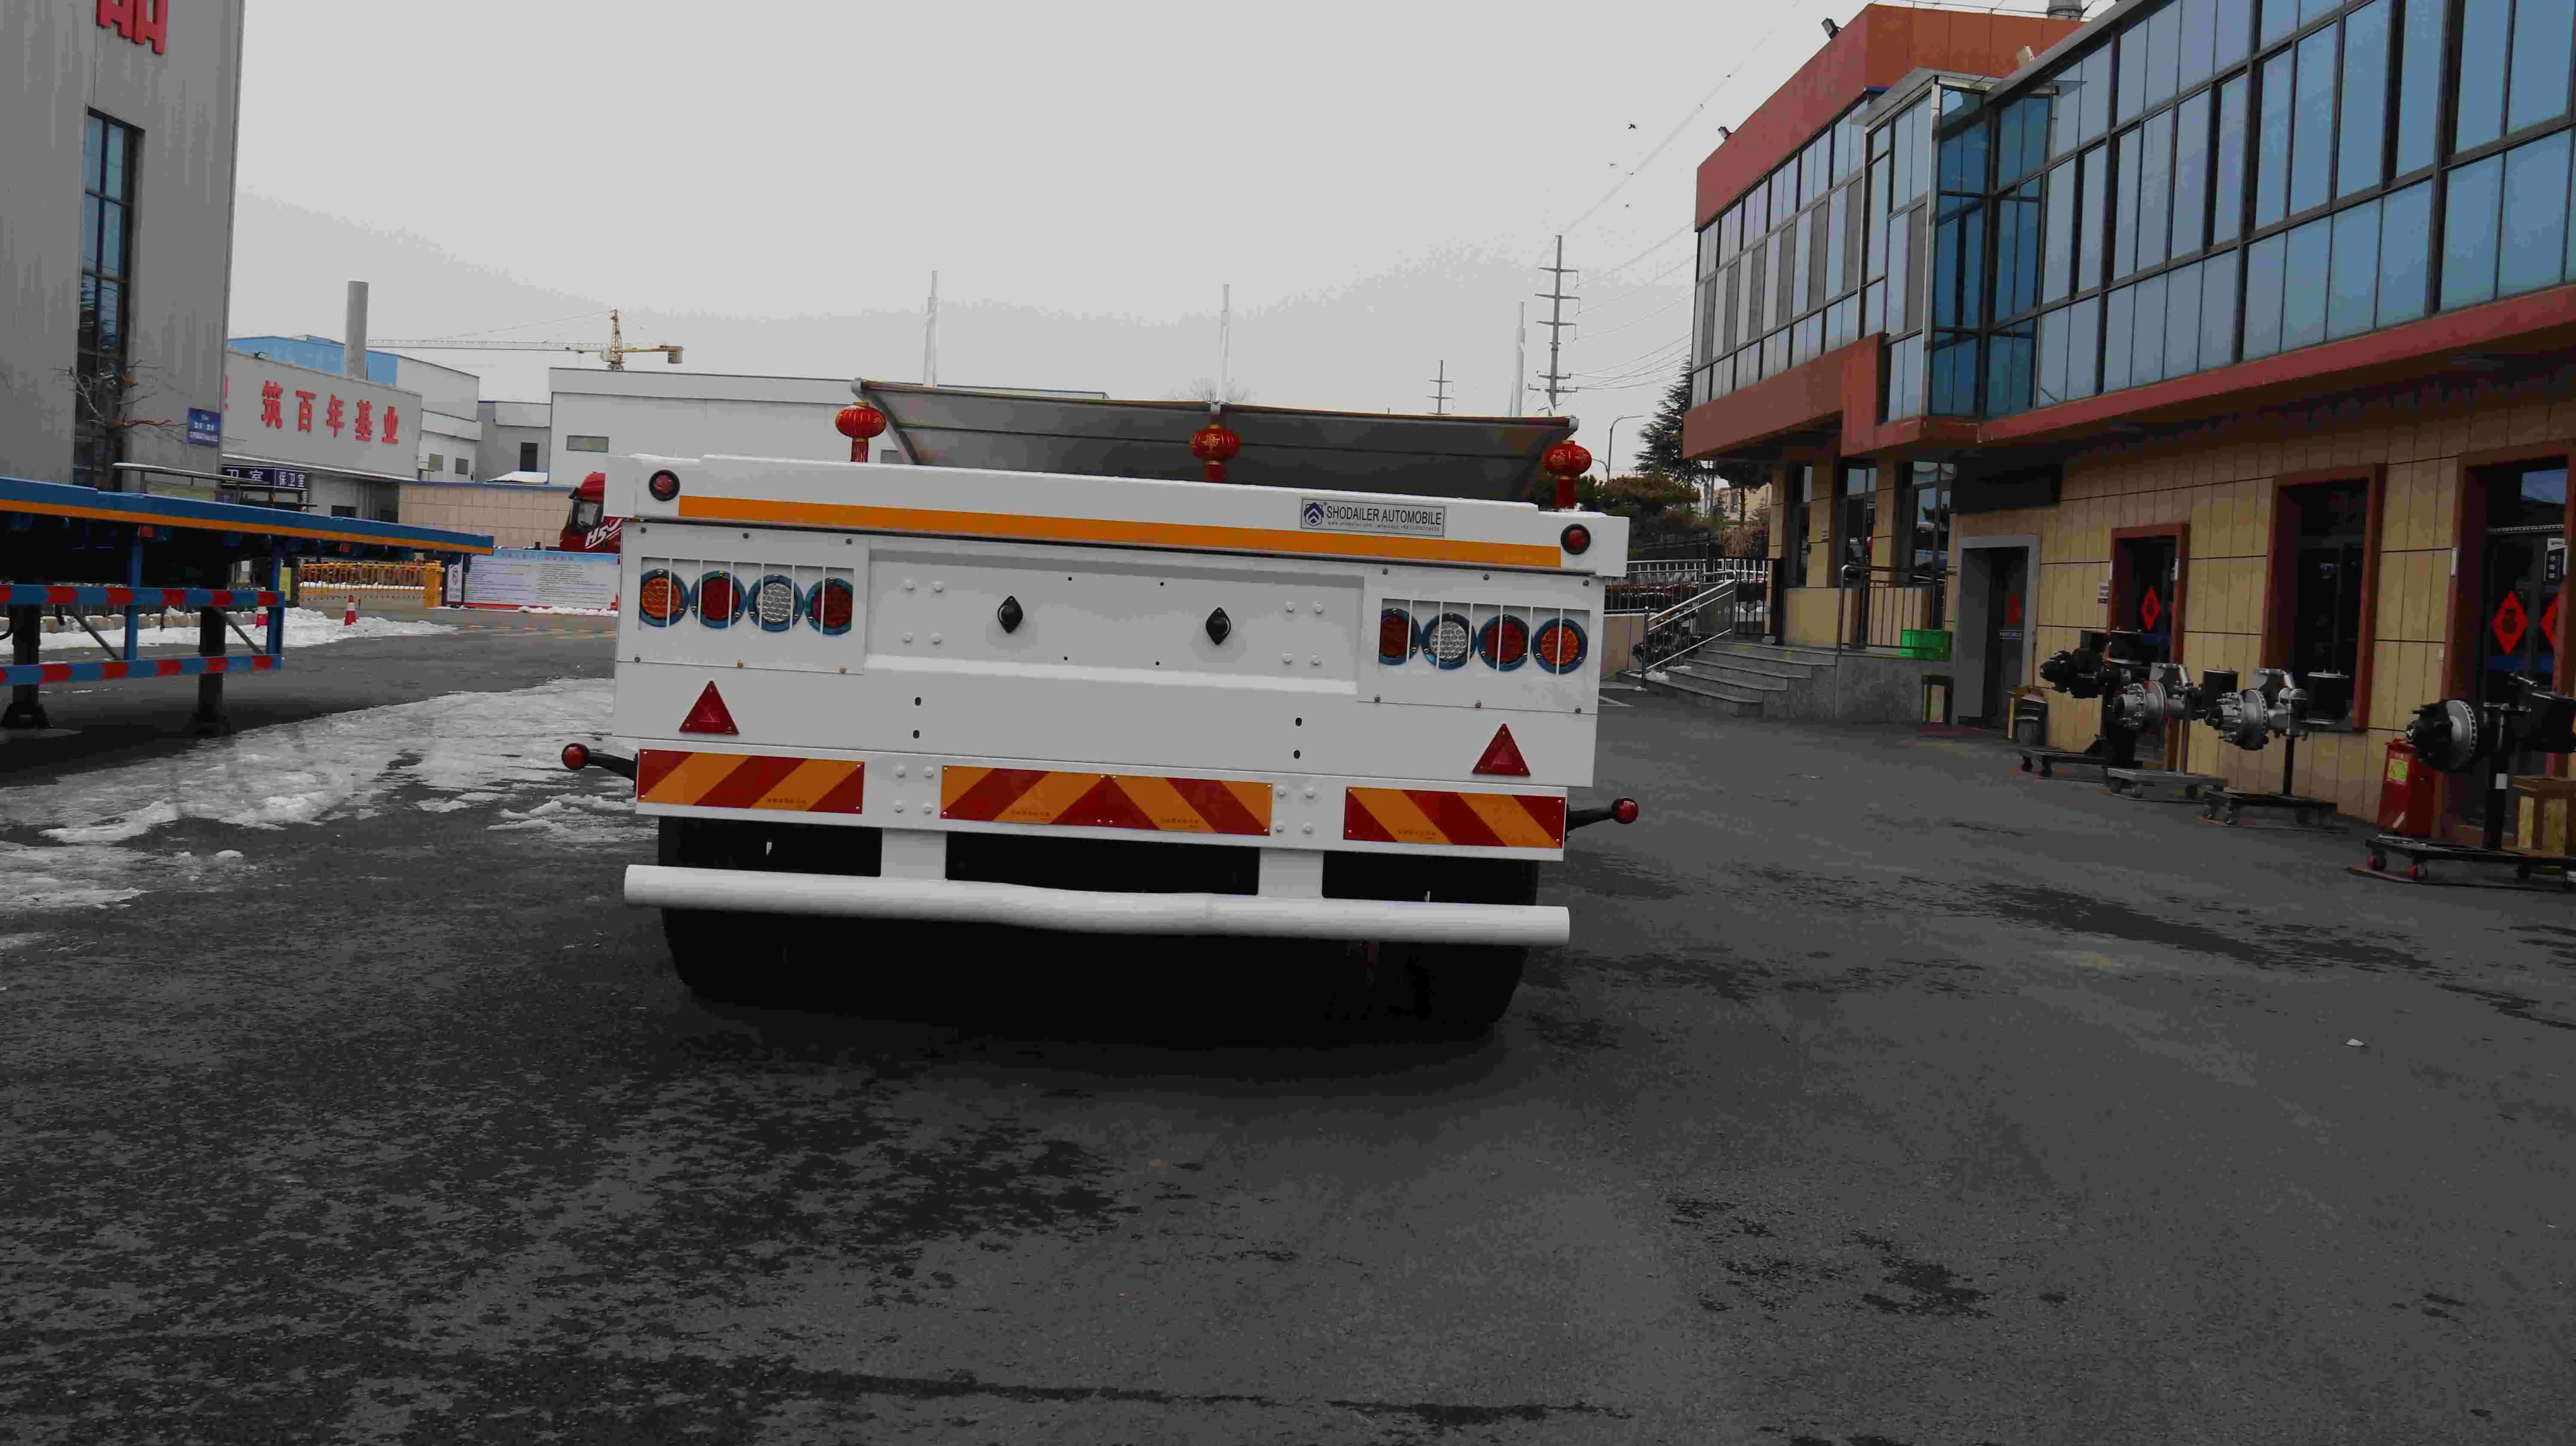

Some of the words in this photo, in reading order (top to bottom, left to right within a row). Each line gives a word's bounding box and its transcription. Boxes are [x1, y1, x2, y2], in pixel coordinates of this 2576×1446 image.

[261, 380, 399, 444] 筑百年基业
[279, 471, 305, 487] 保卫室
[1326, 505, 1379, 522] SHODAILER
[1382, 509, 1441, 526] AUTOMOBILE
